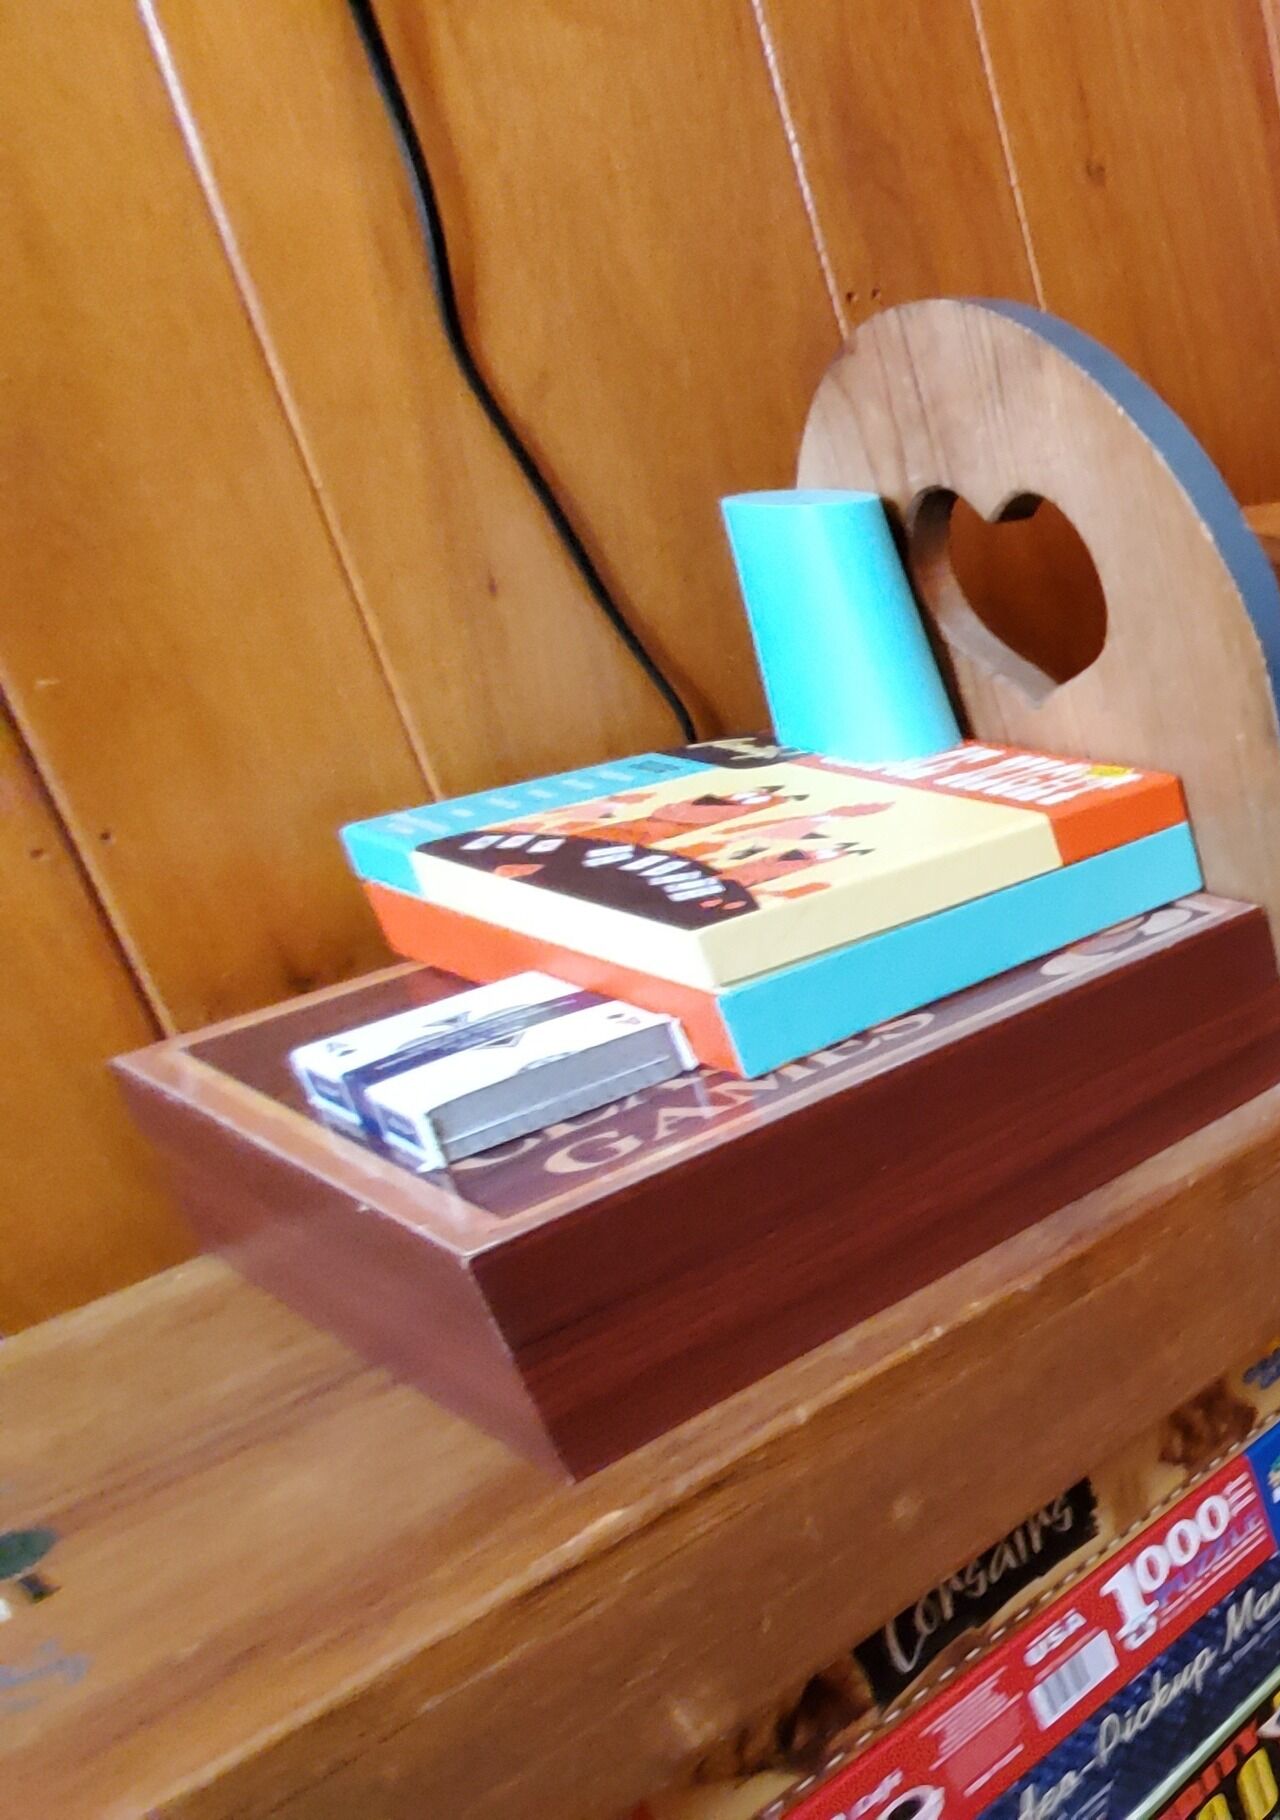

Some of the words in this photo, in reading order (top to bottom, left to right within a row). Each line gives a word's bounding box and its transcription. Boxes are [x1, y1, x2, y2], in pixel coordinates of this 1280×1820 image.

[544, 1012, 935, 1176] GAMES
[1099, 1494, 1230, 1642] 1000
[1152, 1512, 1263, 1607] PUZZLE
